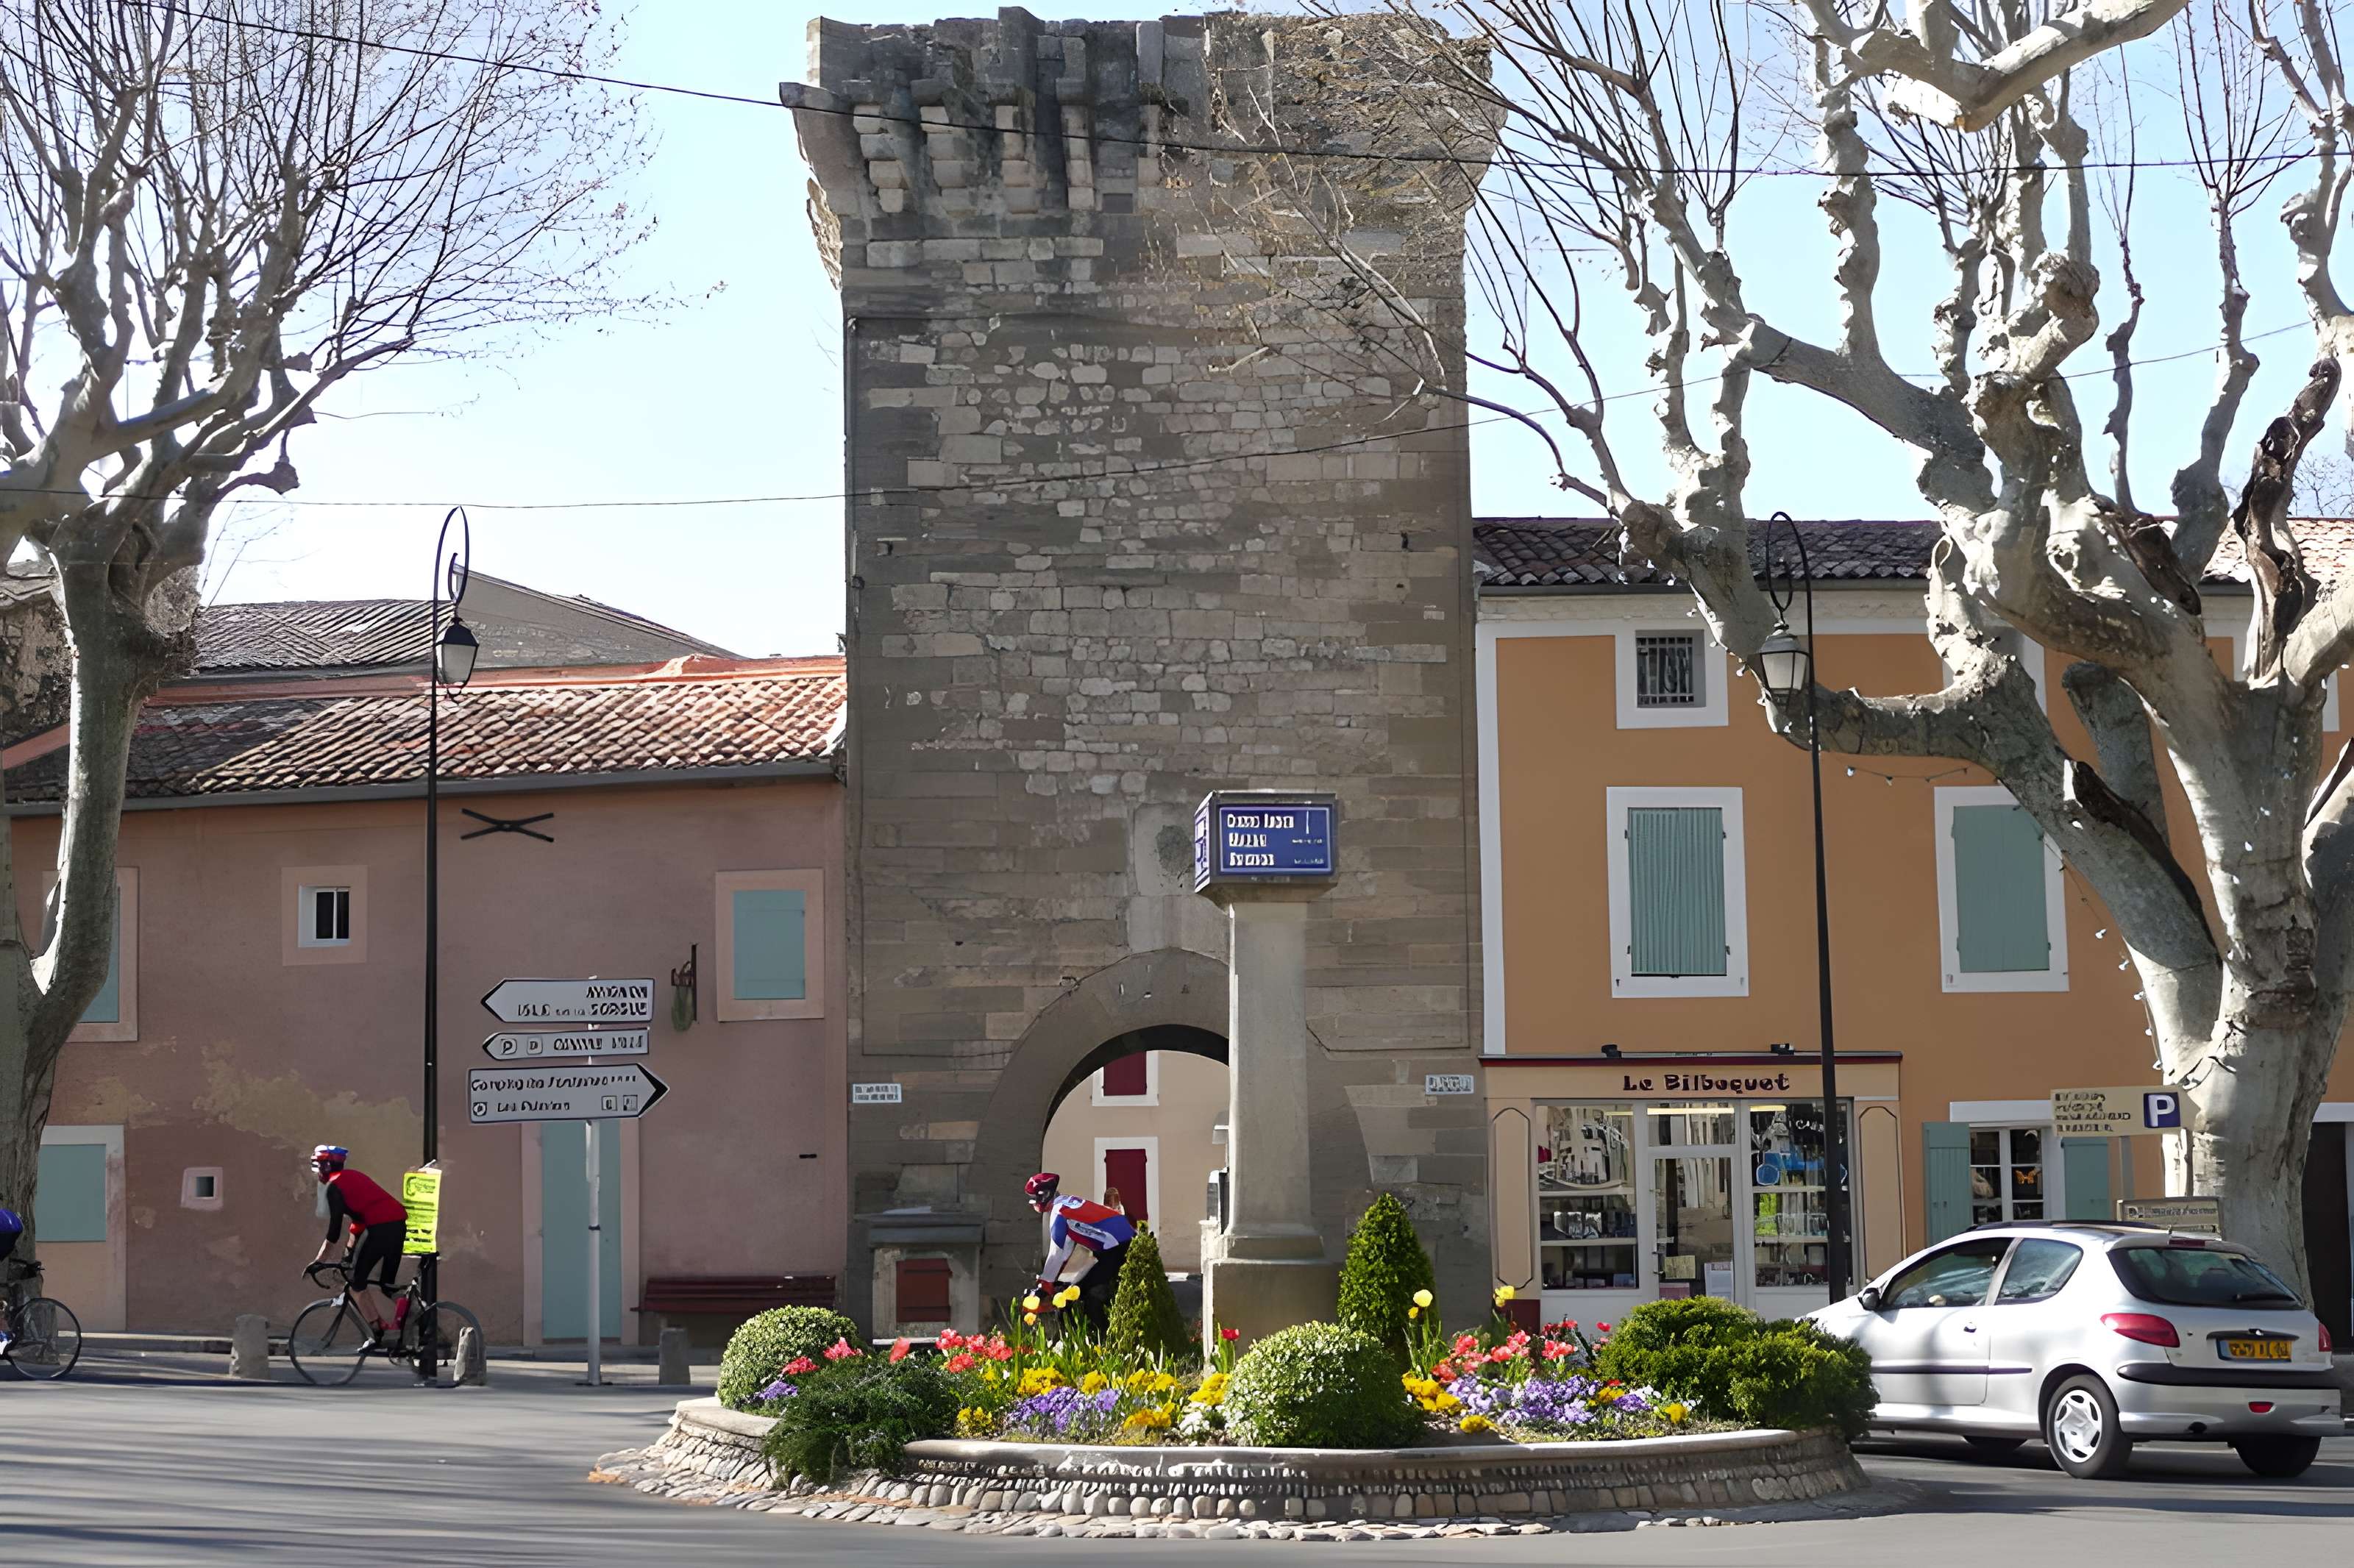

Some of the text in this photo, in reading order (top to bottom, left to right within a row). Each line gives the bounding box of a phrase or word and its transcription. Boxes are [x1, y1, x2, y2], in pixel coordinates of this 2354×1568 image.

[1623, 1073, 1790, 1094] Le Bilboquet
[2148, 1094, 2175, 1127] P
